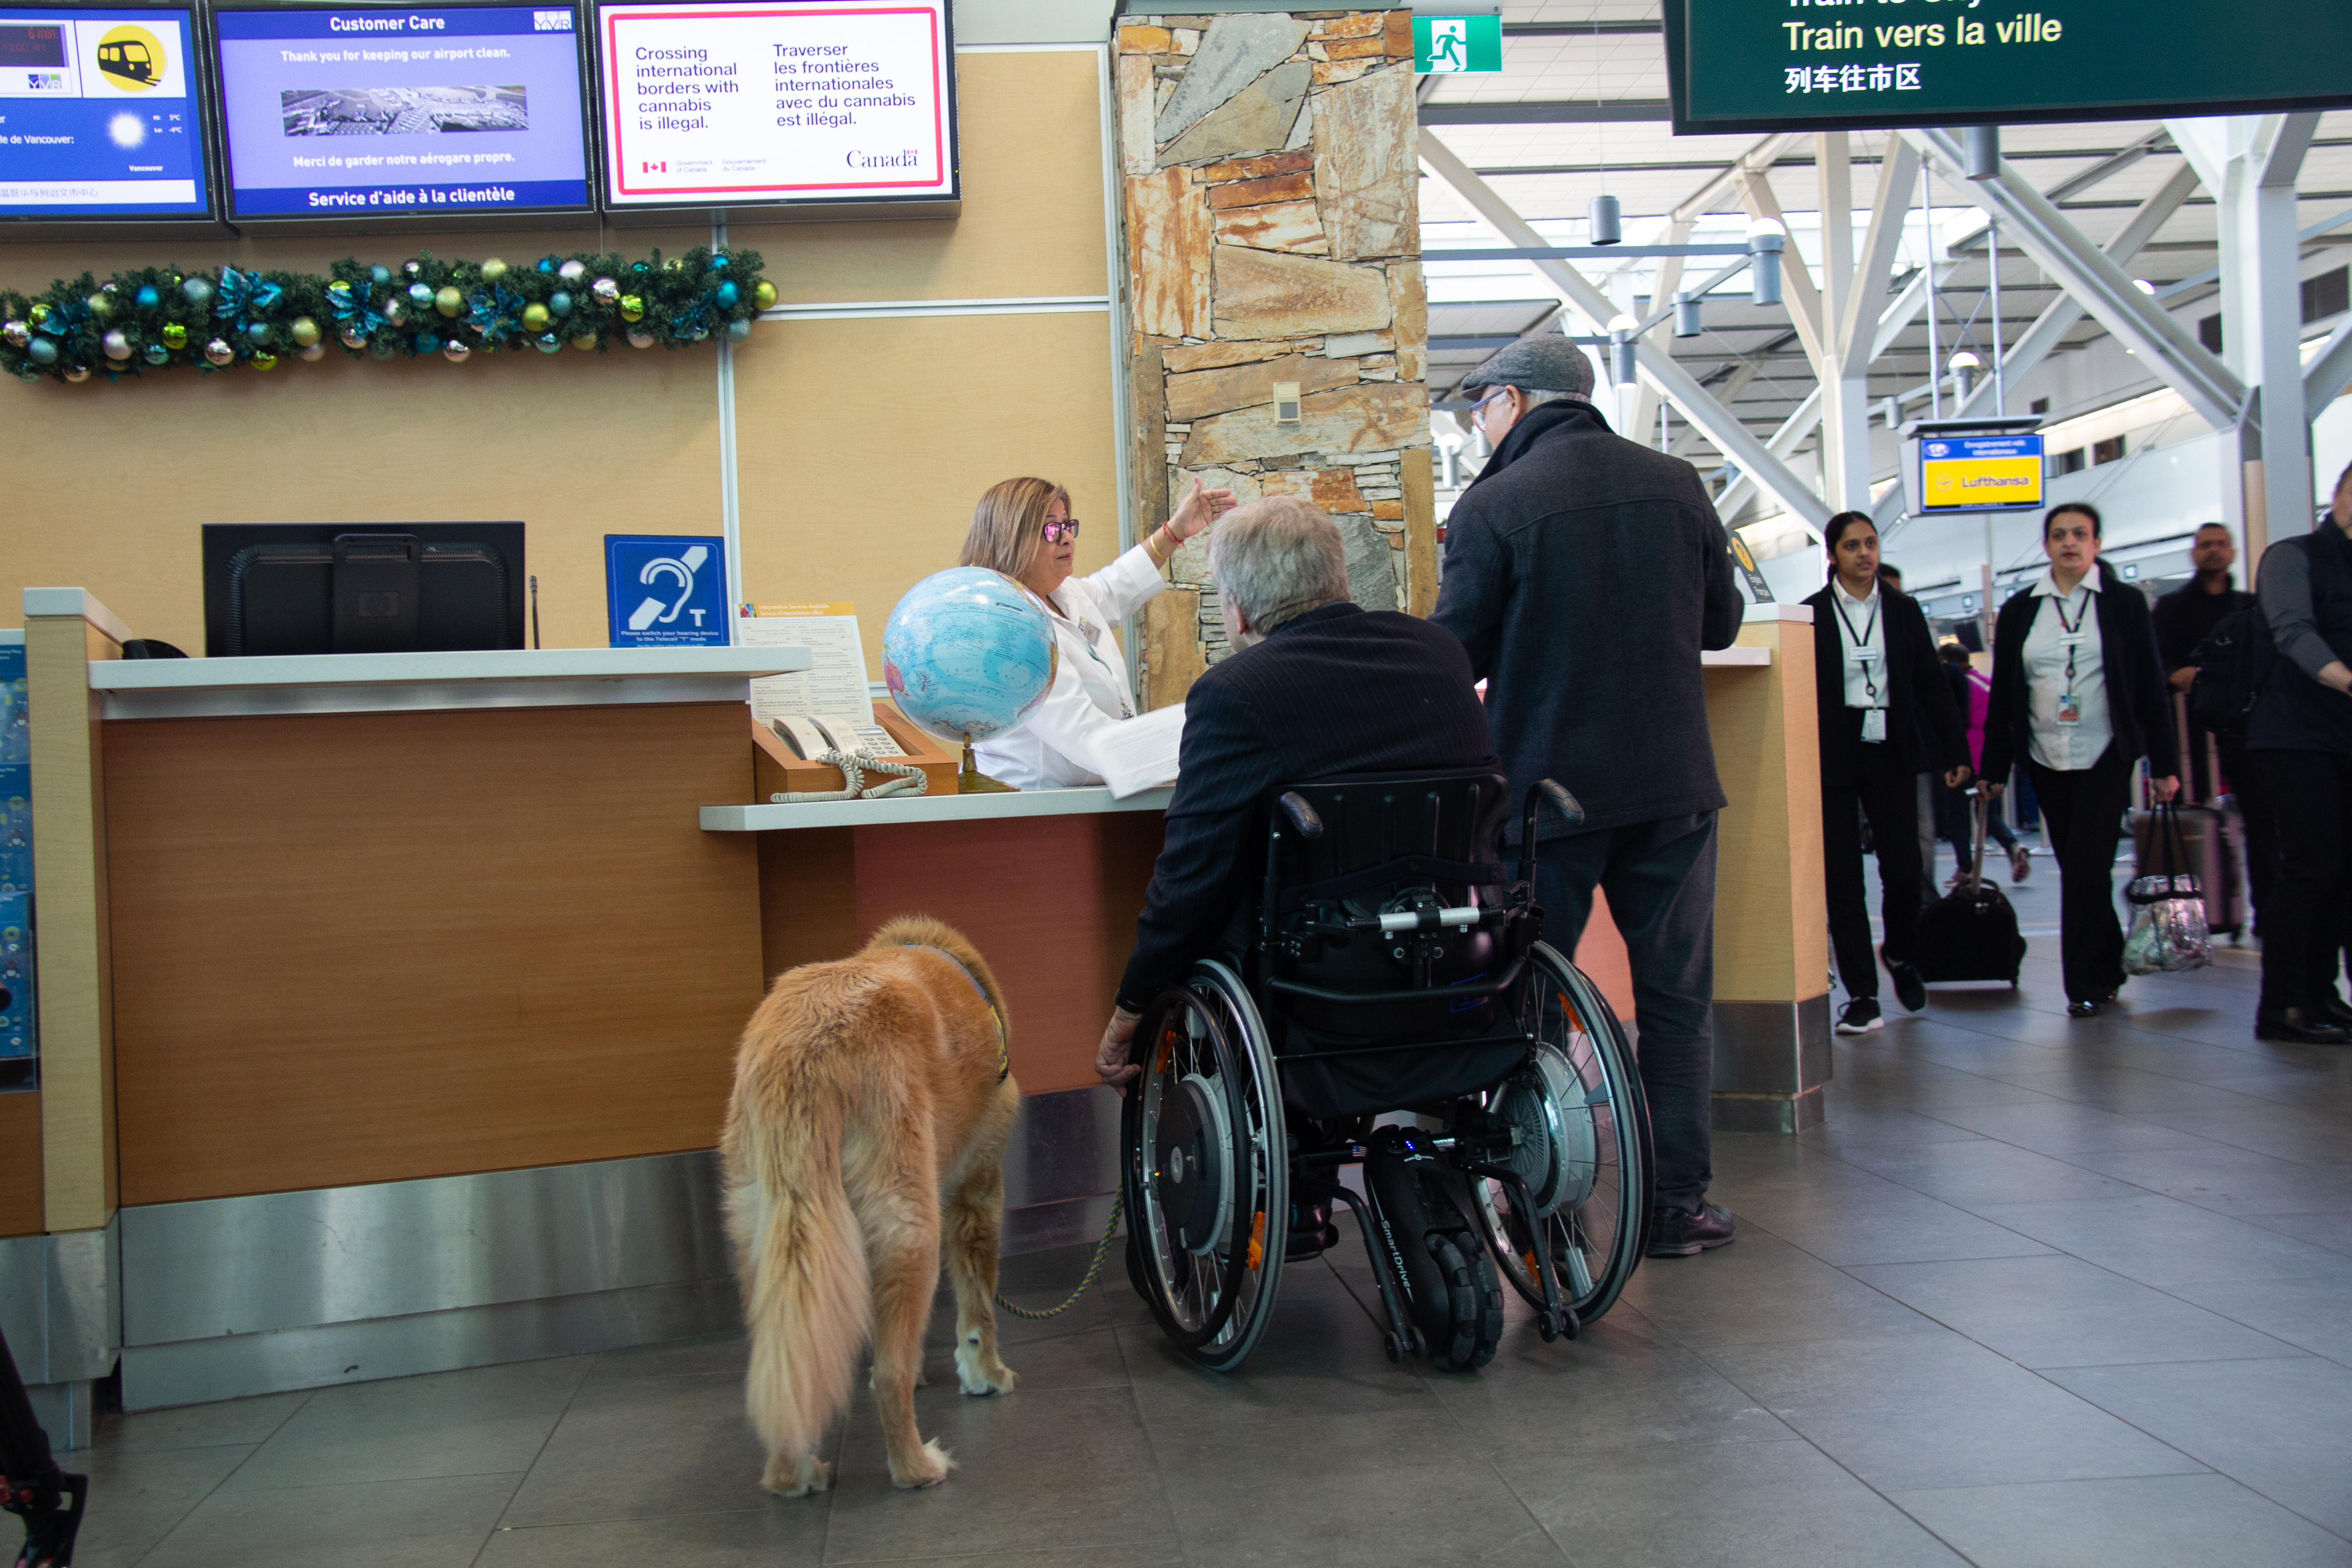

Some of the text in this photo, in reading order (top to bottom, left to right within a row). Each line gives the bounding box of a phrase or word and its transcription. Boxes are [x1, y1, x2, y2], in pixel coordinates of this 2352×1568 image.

[330, 15, 445, 31] Customer Care
[28, 27, 34, 39] 6
[1782, 13, 2063, 50] Train vers la ville
[281, 47, 510, 64] Thank you for keeping our airport clean.
[635, 46, 708, 62] Crossing
[774, 44, 848, 58] Traverser
[637, 63, 737, 77] international
[774, 59, 879, 74] les frontières
[775, 78, 894, 92] internationales
[1784, 62, 1922, 93] 列车往市区
[638, 80, 739, 95] borders with
[638, 98, 711, 113] cannabis
[776, 93, 916, 110] avec du cannabis
[640, 115, 708, 132] is illegal.
[777, 111, 857, 127] est illégal.
[23, 135, 74, 144] Vancouver:
[293, 152, 515, 169] Merci de garder notre aérogare propre.
[847, 150, 918, 169] Canada
[309, 187, 514, 206] Service d'aide à la clientèle
[1962, 476, 2029, 488] Lufthansa
[995, 602, 1023, 612] globemaster
[689, 609, 706, 627] T
[1381, 1220, 1411, 1287] SmartDrive
